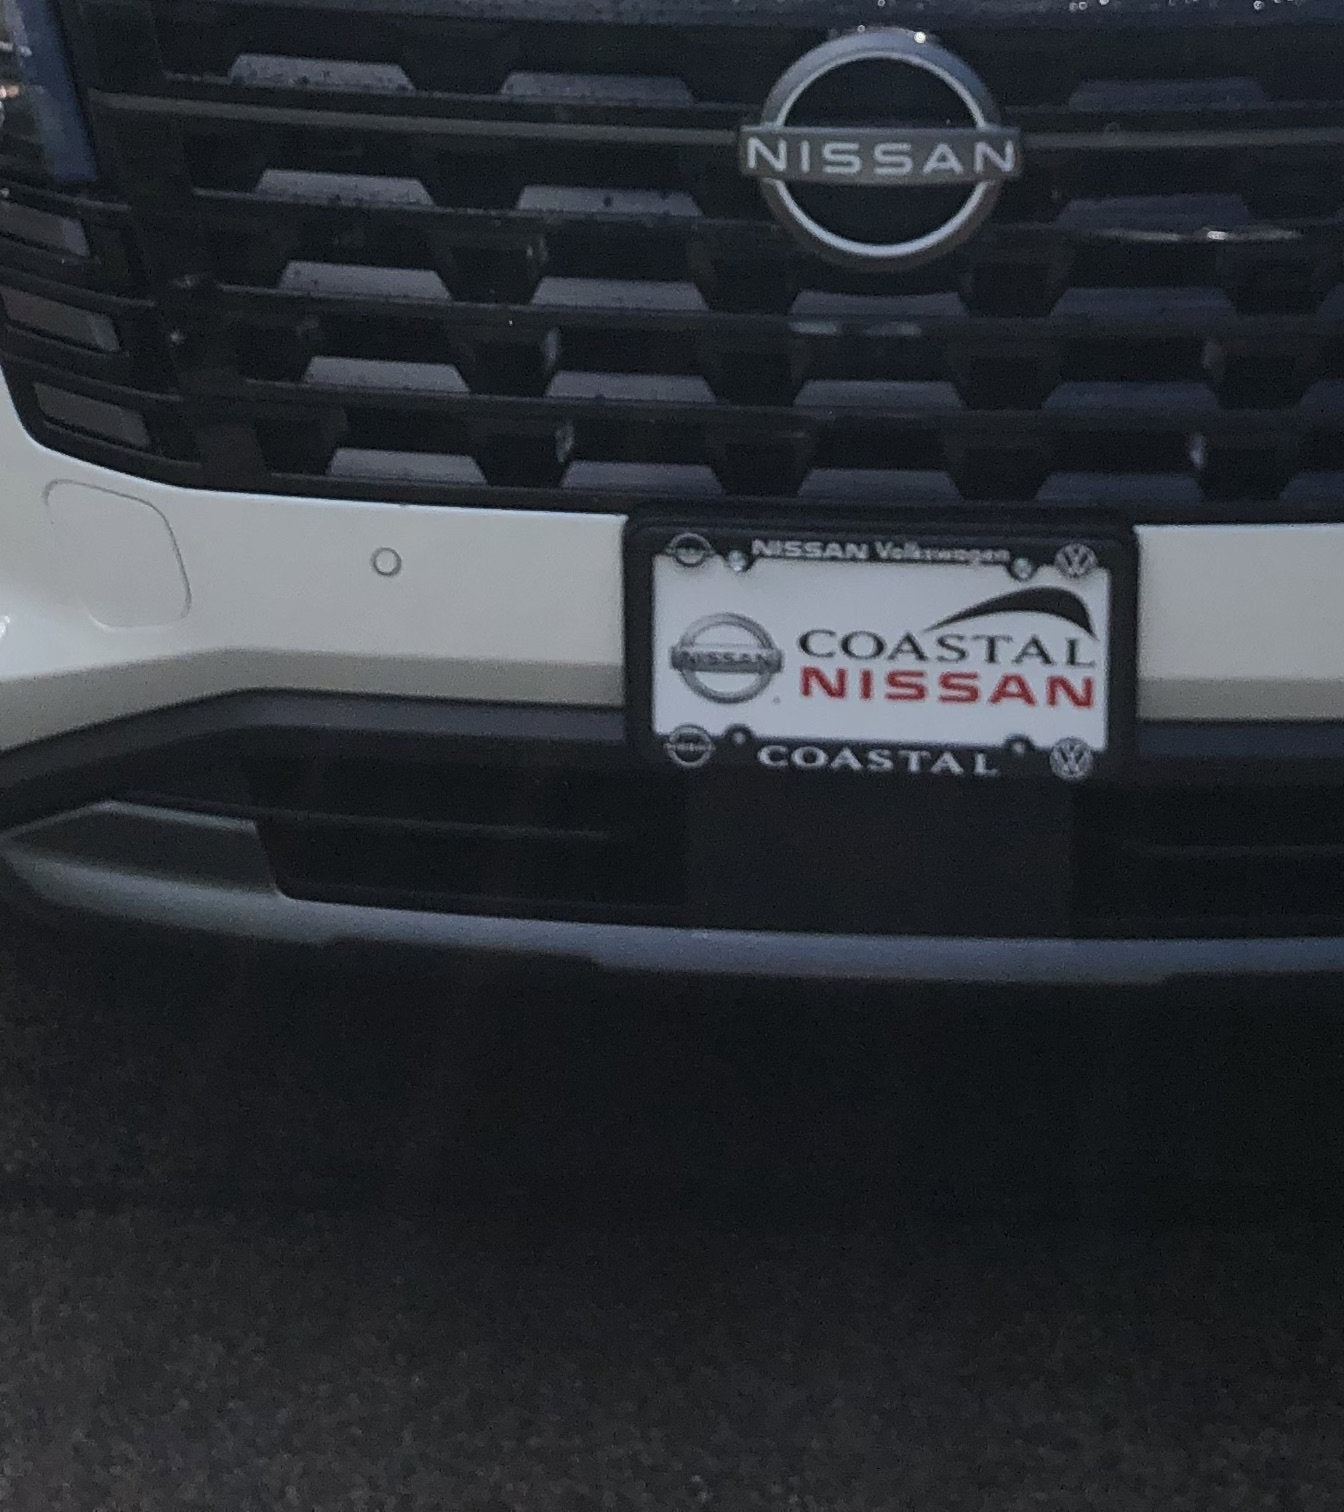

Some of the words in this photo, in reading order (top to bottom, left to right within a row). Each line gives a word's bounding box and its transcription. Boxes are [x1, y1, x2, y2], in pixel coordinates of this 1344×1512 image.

[747, 137, 1015, 175] NISSAN
[752, 539, 869, 560] NISSAN
[798, 629, 1095, 668] COASTAL
[800, 665, 1094, 709] NISSAN
[757, 744, 1001, 777] COASTAL
